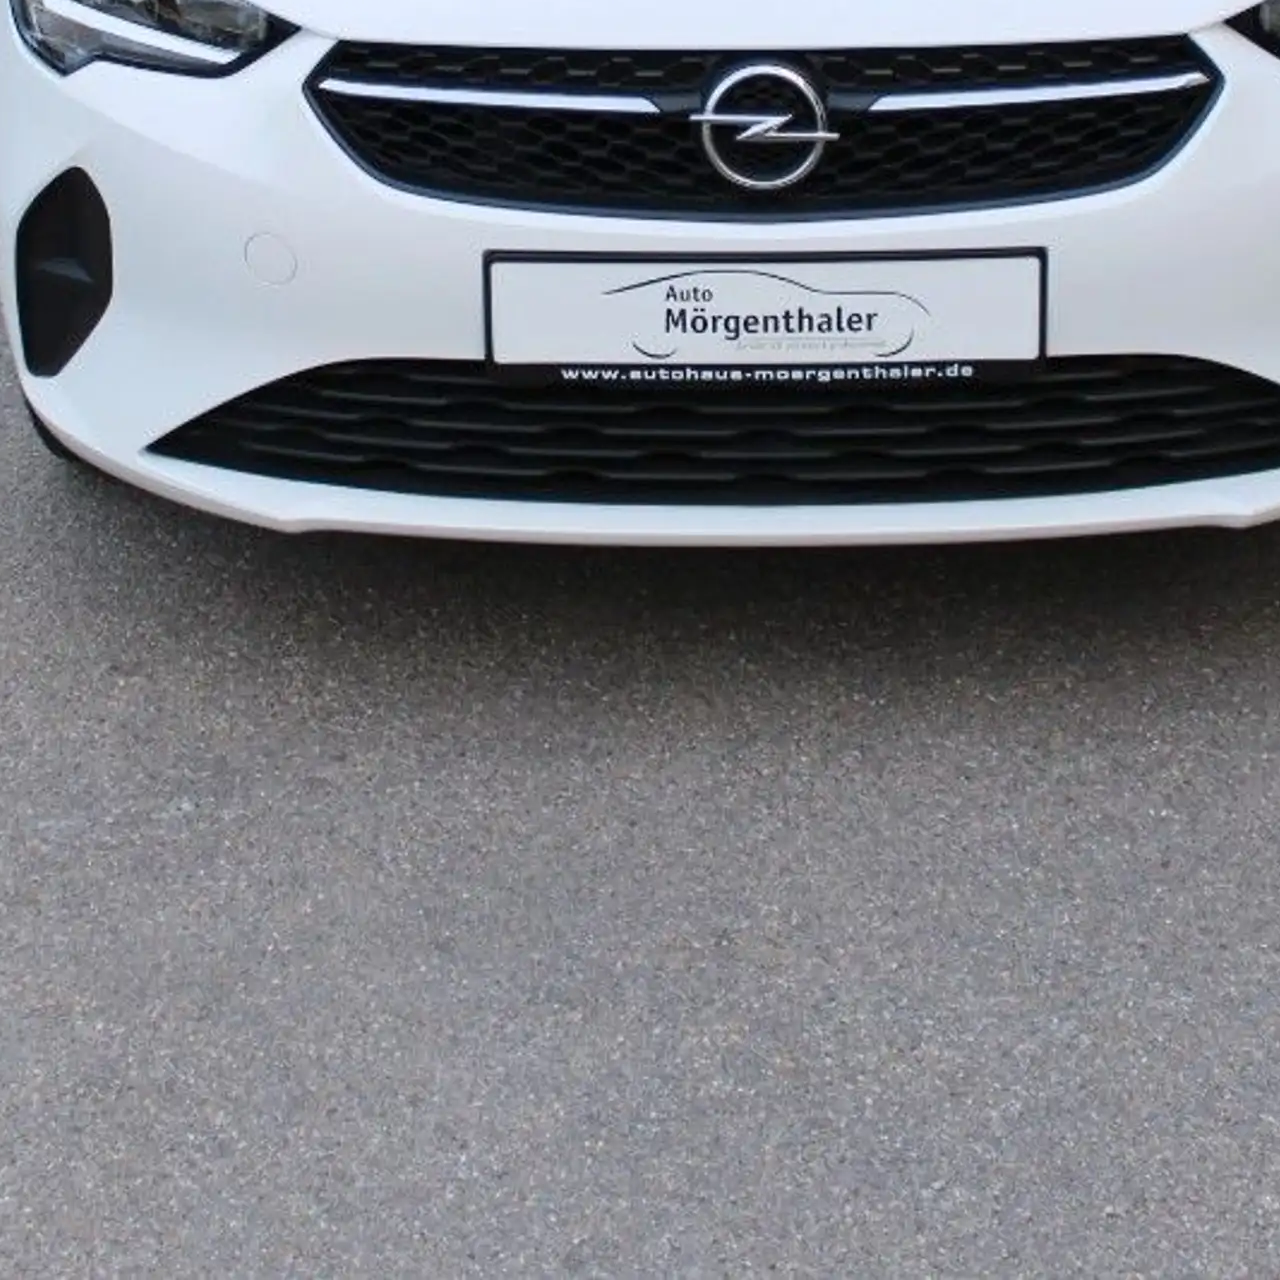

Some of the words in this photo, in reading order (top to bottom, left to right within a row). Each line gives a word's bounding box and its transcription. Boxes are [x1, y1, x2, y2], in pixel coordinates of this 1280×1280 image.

[665, 285, 714, 303] Auto
[665, 305, 879, 341] Mörgenthaler
[561, 363, 974, 382] www.autohaus-moergenthaler.de
